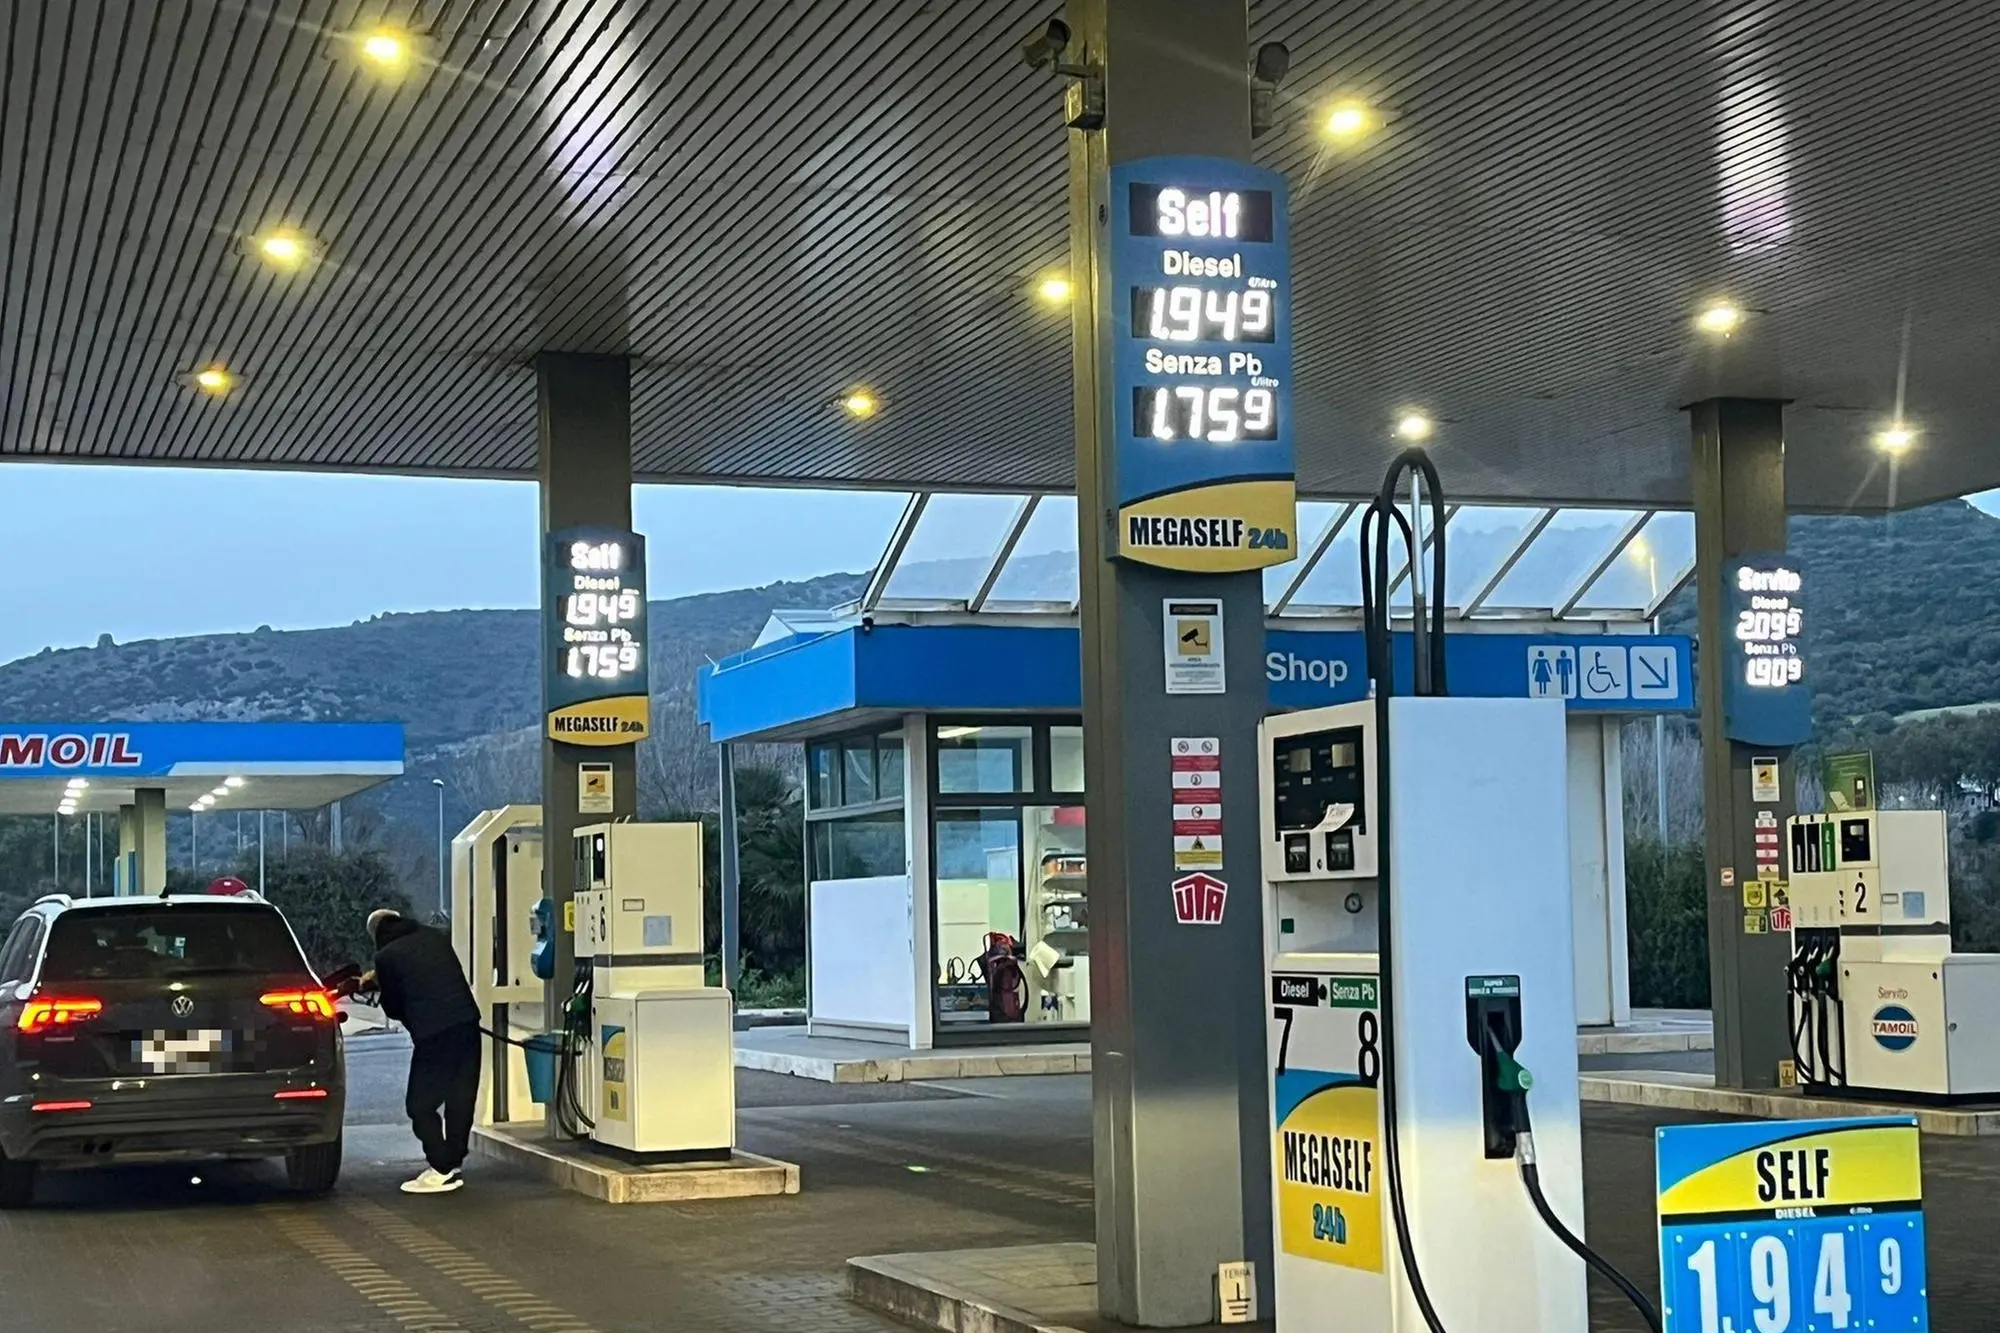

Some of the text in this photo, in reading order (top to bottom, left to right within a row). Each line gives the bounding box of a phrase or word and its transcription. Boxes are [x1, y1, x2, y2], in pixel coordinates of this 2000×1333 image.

[1157, 187, 1240, 238] Self
[1163, 250, 1241, 278] Diesel
[1145, 348, 1262, 376] Senza Pb
[1129, 516, 1288, 549] MEGASELF 24h
[571, 542, 620, 569] Self
[574, 575, 620, 590] Diesel
[611, 628, 631, 641] Pb
[1781, 643, 1797, 655] Pb
[1265, 652, 1348, 688] Shop
[555, 716, 618, 732] MEGASELF
[1855, 882, 1867, 913] 2
[1280, 980, 1375, 1000] Diesel Senza Pb
[1873, 1022, 1917, 1034] TAMOIL
[1274, 1006, 1380, 1083] 7 8
[1284, 1131, 1371, 1193] MEGASELF
[1756, 1148, 1829, 1202] SELF
[1312, 1203, 1346, 1244] 24h
[1775, 1207, 1816, 1219] DIESEL
